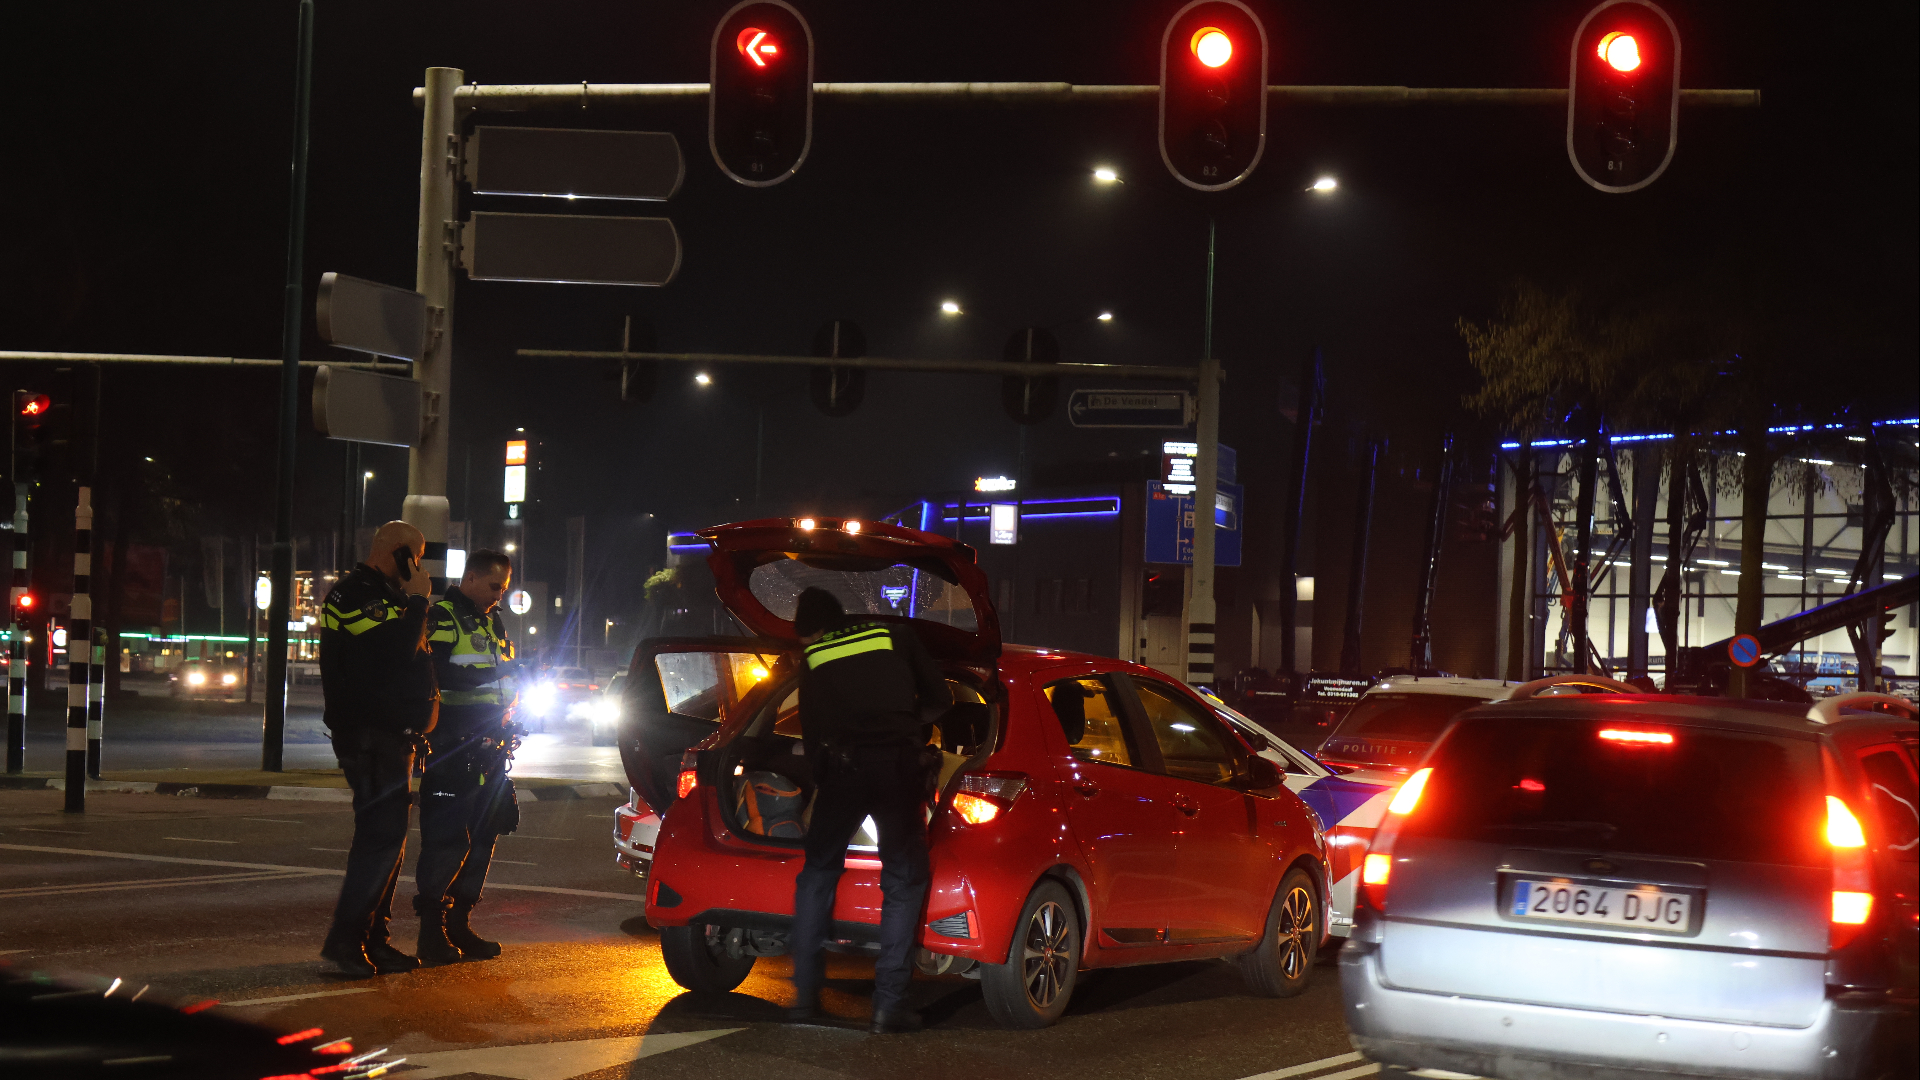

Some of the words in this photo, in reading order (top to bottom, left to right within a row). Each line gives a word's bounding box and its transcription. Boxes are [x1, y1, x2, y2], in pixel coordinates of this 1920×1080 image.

[1342, 744, 1398, 755] POLITIE
[1533, 886, 1609, 916] 2064
[1623, 893, 1683, 925] DJG
